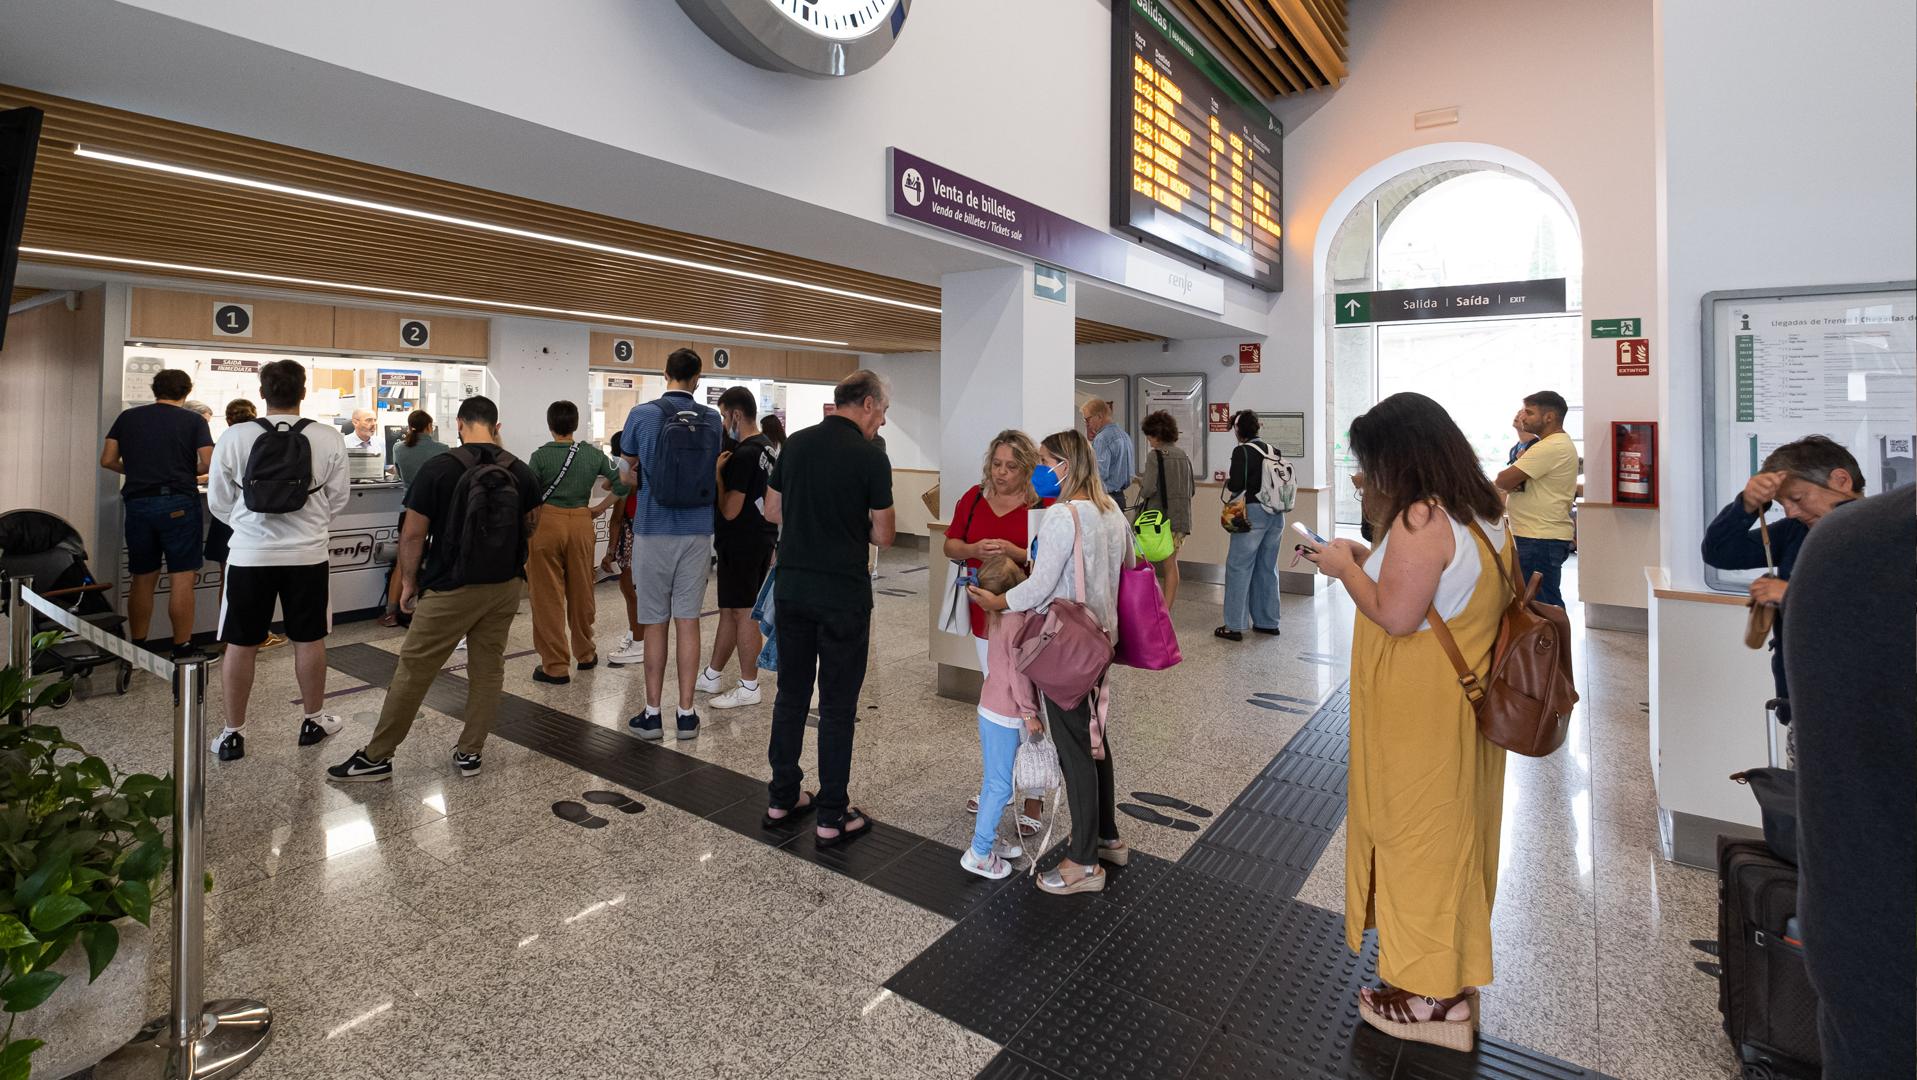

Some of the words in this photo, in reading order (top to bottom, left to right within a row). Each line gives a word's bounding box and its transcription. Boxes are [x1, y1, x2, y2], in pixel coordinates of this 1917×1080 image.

[932, 177, 963, 204] Venta
[966, 190, 979, 210] de
[982, 194, 1016, 222] billetes
[932, 201, 954, 218] Venda
[954, 209, 963, 222] de
[964, 212, 987, 229] billetes
[991, 222, 1010, 238] Tickets
[1010, 229, 1022, 241] sale
[1168, 272, 1193, 296] renfe
[1403, 298, 1438, 310] Salida
[1456, 295, 1490, 307] Saída
[226, 312, 239, 328] 1
[1772, 320, 1808, 328] Llegadas
[410, 328, 420, 341] 2
[620, 345, 627, 357] 3
[718, 354, 724, 364] 4
[328, 542, 370, 558] renfe
